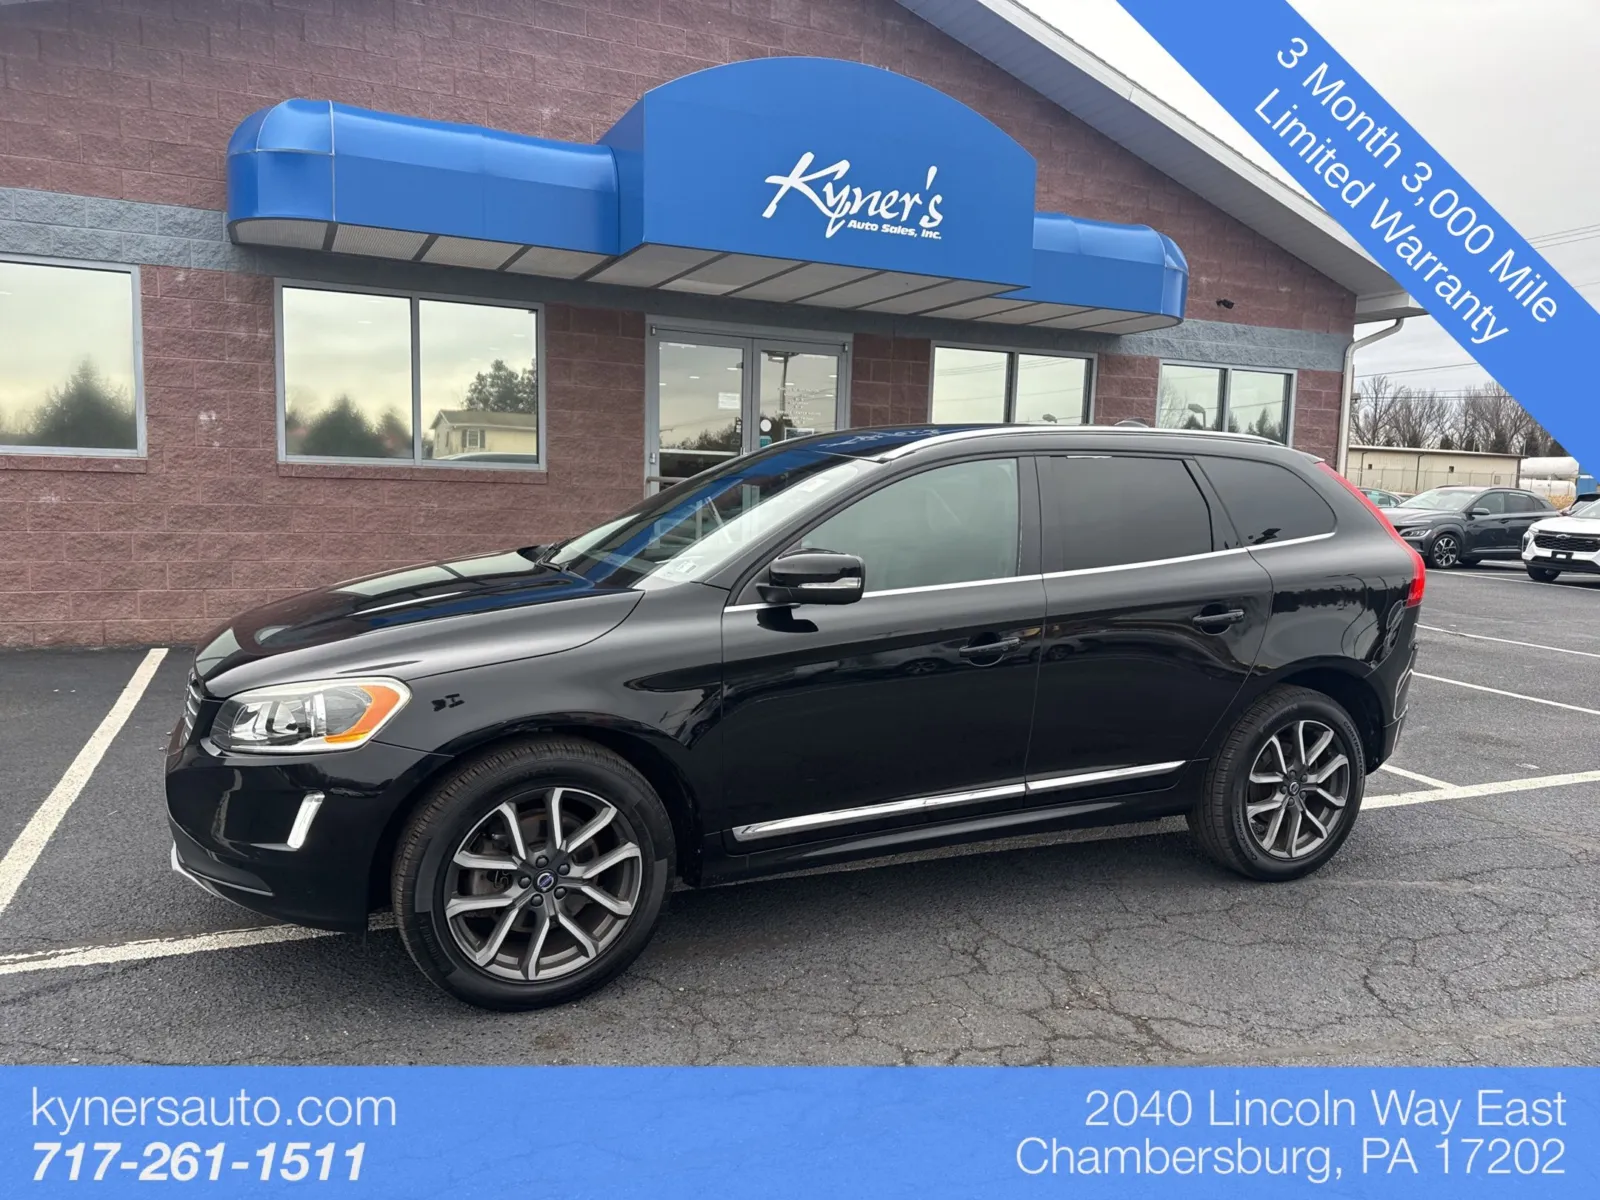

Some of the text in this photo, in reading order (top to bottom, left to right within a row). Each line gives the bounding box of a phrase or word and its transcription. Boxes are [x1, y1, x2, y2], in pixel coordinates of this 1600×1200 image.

[762, 151, 944, 239] Kyner's
[847, 219, 942, 240] Auto Sales, Inc.
